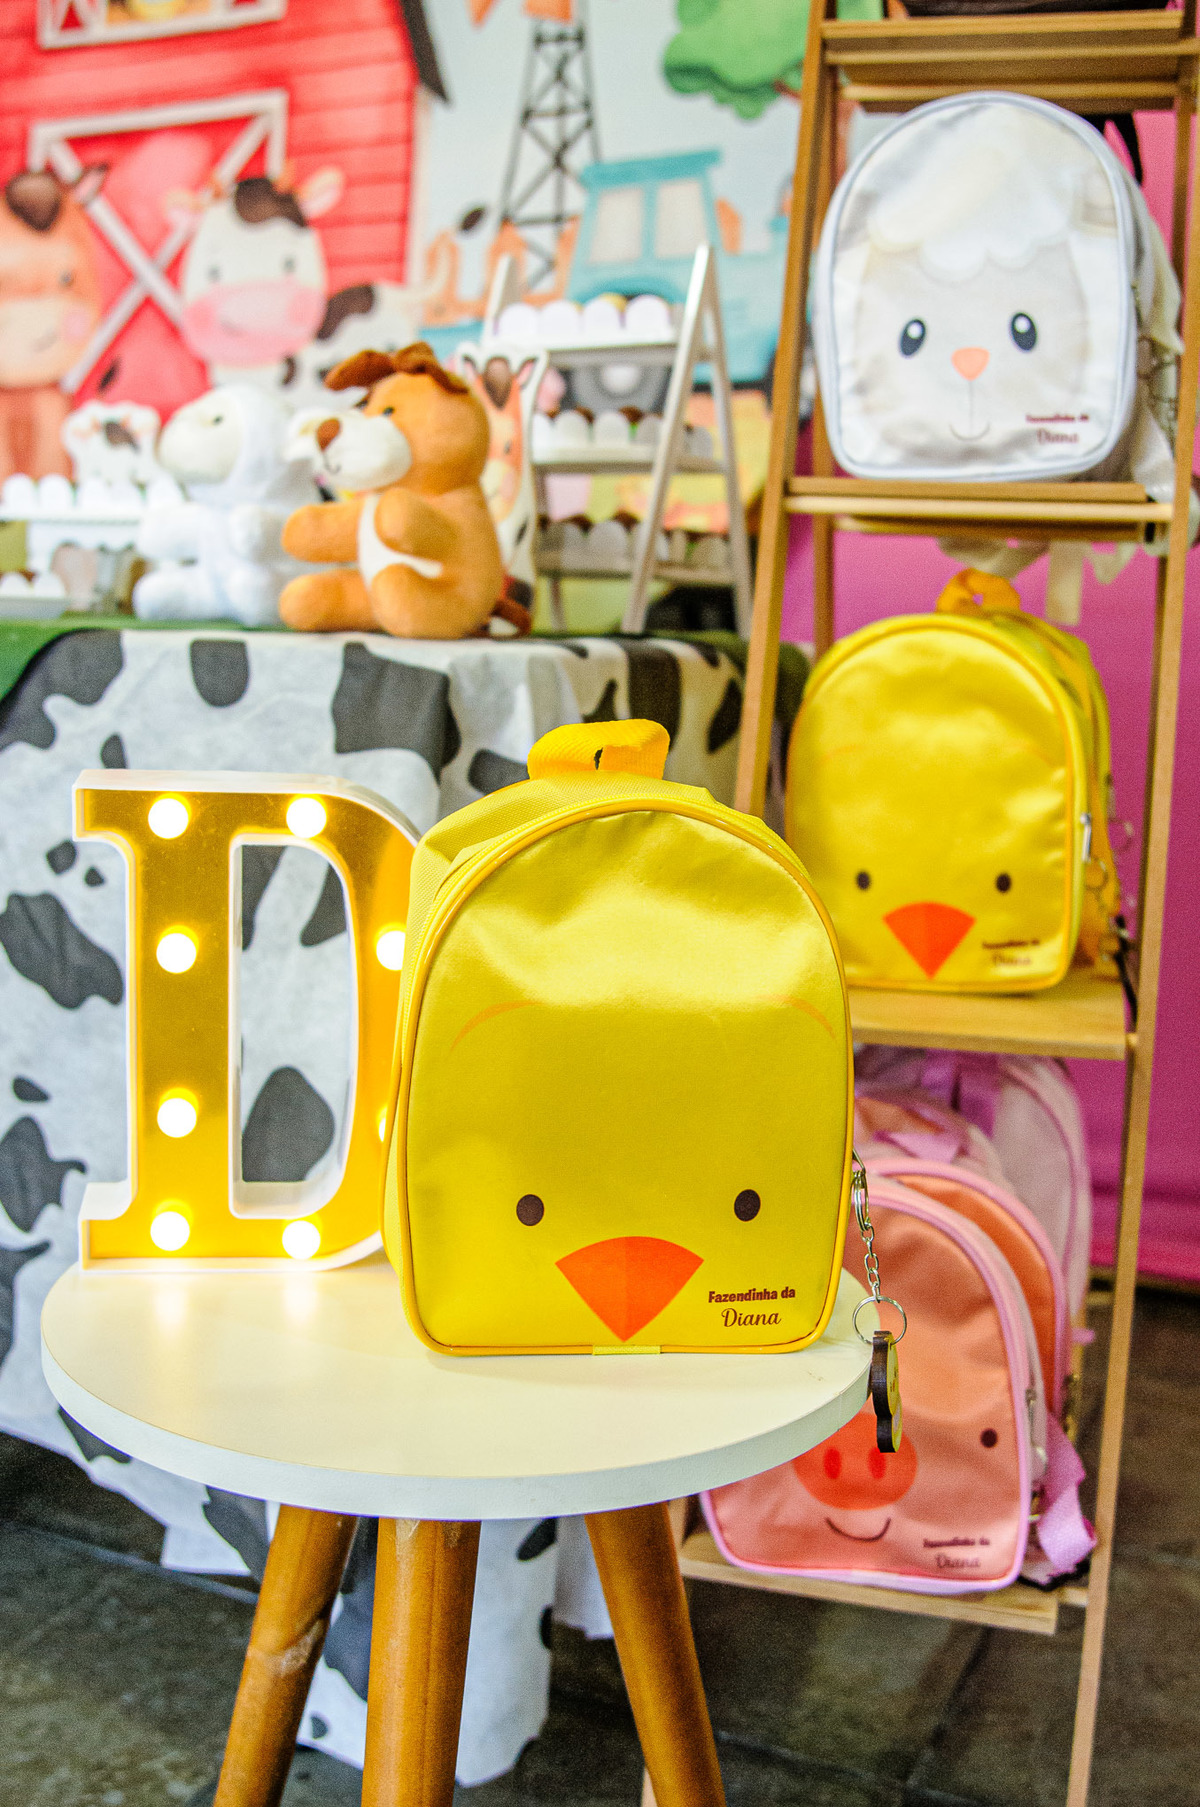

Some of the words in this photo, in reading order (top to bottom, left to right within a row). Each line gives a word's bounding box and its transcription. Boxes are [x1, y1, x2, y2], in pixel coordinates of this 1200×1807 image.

[73, 770, 418, 1272] D
[708, 1288, 778, 1303] Fazendinha
[780, 1286, 796, 1299] da
[721, 1307, 782, 1328] Diana
